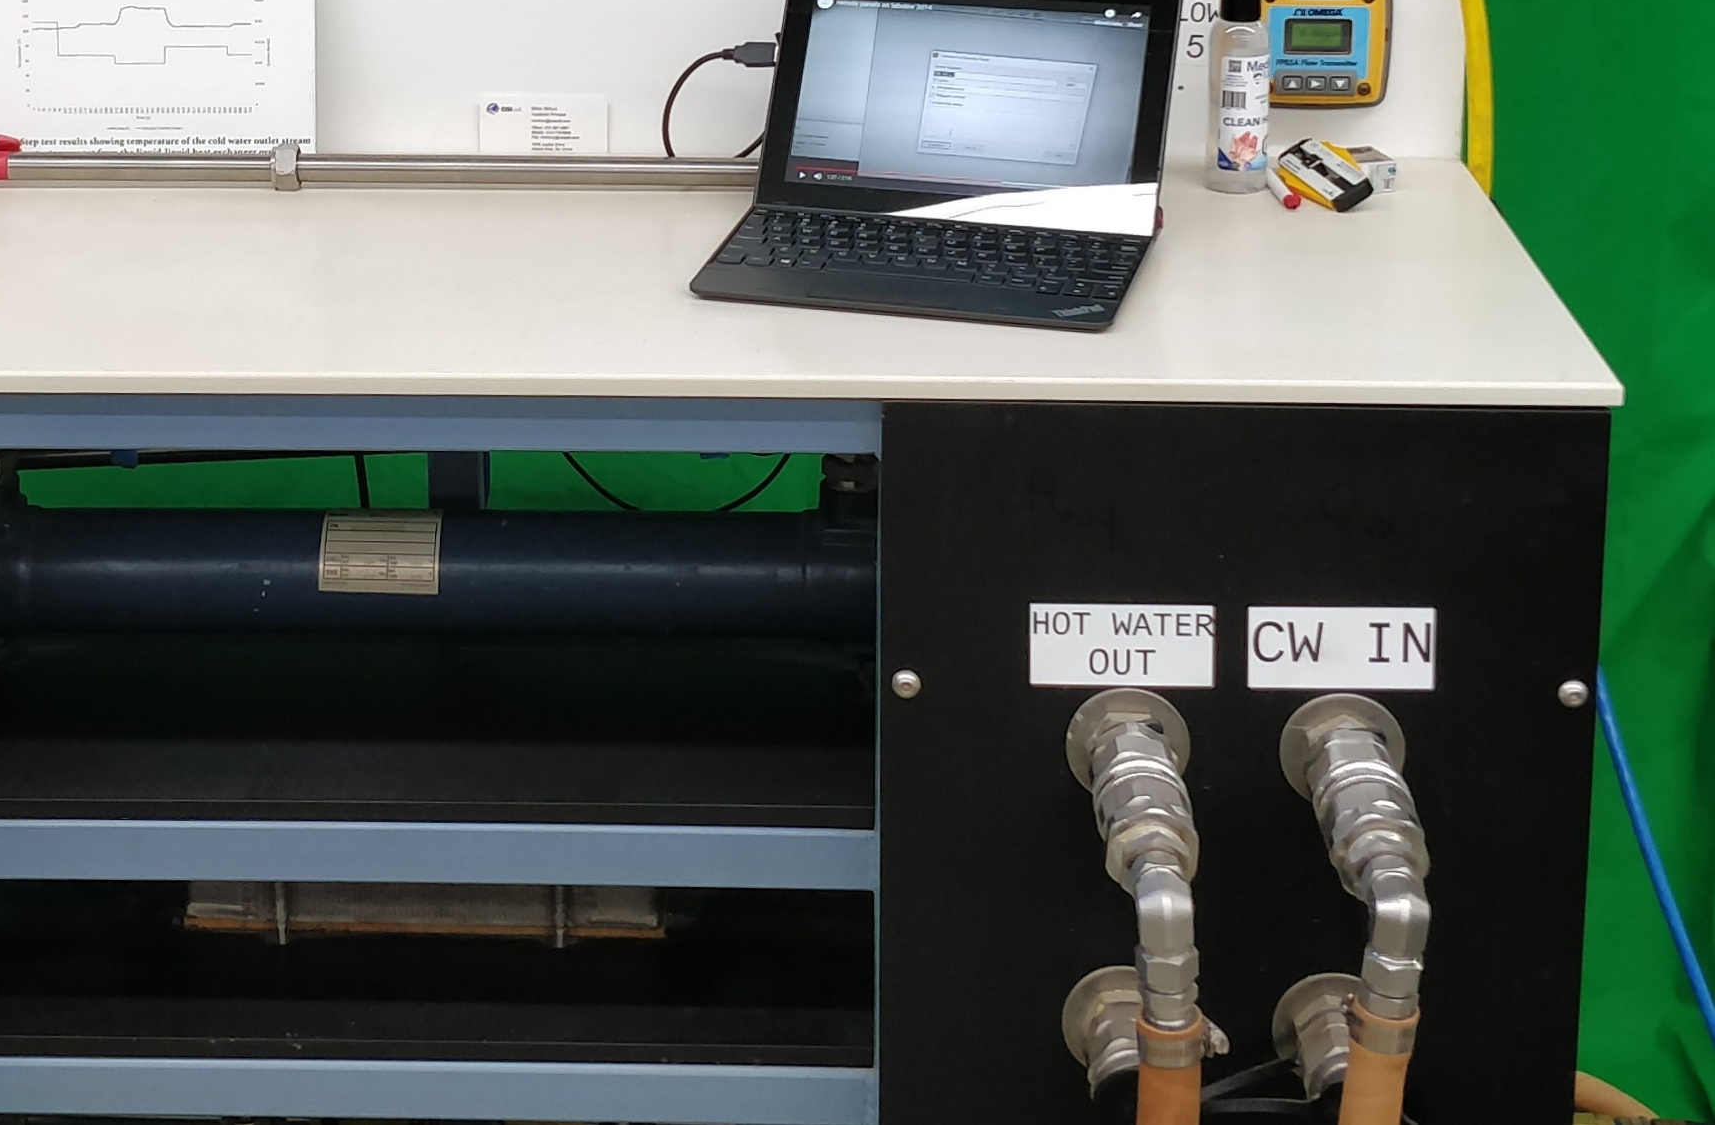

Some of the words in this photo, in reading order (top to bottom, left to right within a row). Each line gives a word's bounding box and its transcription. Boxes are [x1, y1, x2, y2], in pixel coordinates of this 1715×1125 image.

[1223, 117, 1260, 127] CLEAN
[59, 137, 87, 146] results
[90, 137, 124, 148] showing
[127, 138, 179, 147] temperature
[181, 136, 190, 145] of
[192, 136, 206, 145] the
[208, 136, 226, 145] cold
[254, 136, 279, 148] outlet
[1033, 611, 1091, 635] HOT
[1112, 612, 1215, 637] WATER
[1252, 621, 1324, 663] CW
[1369, 622, 1432, 663] IN
[1088, 648, 1156, 676] OUT
